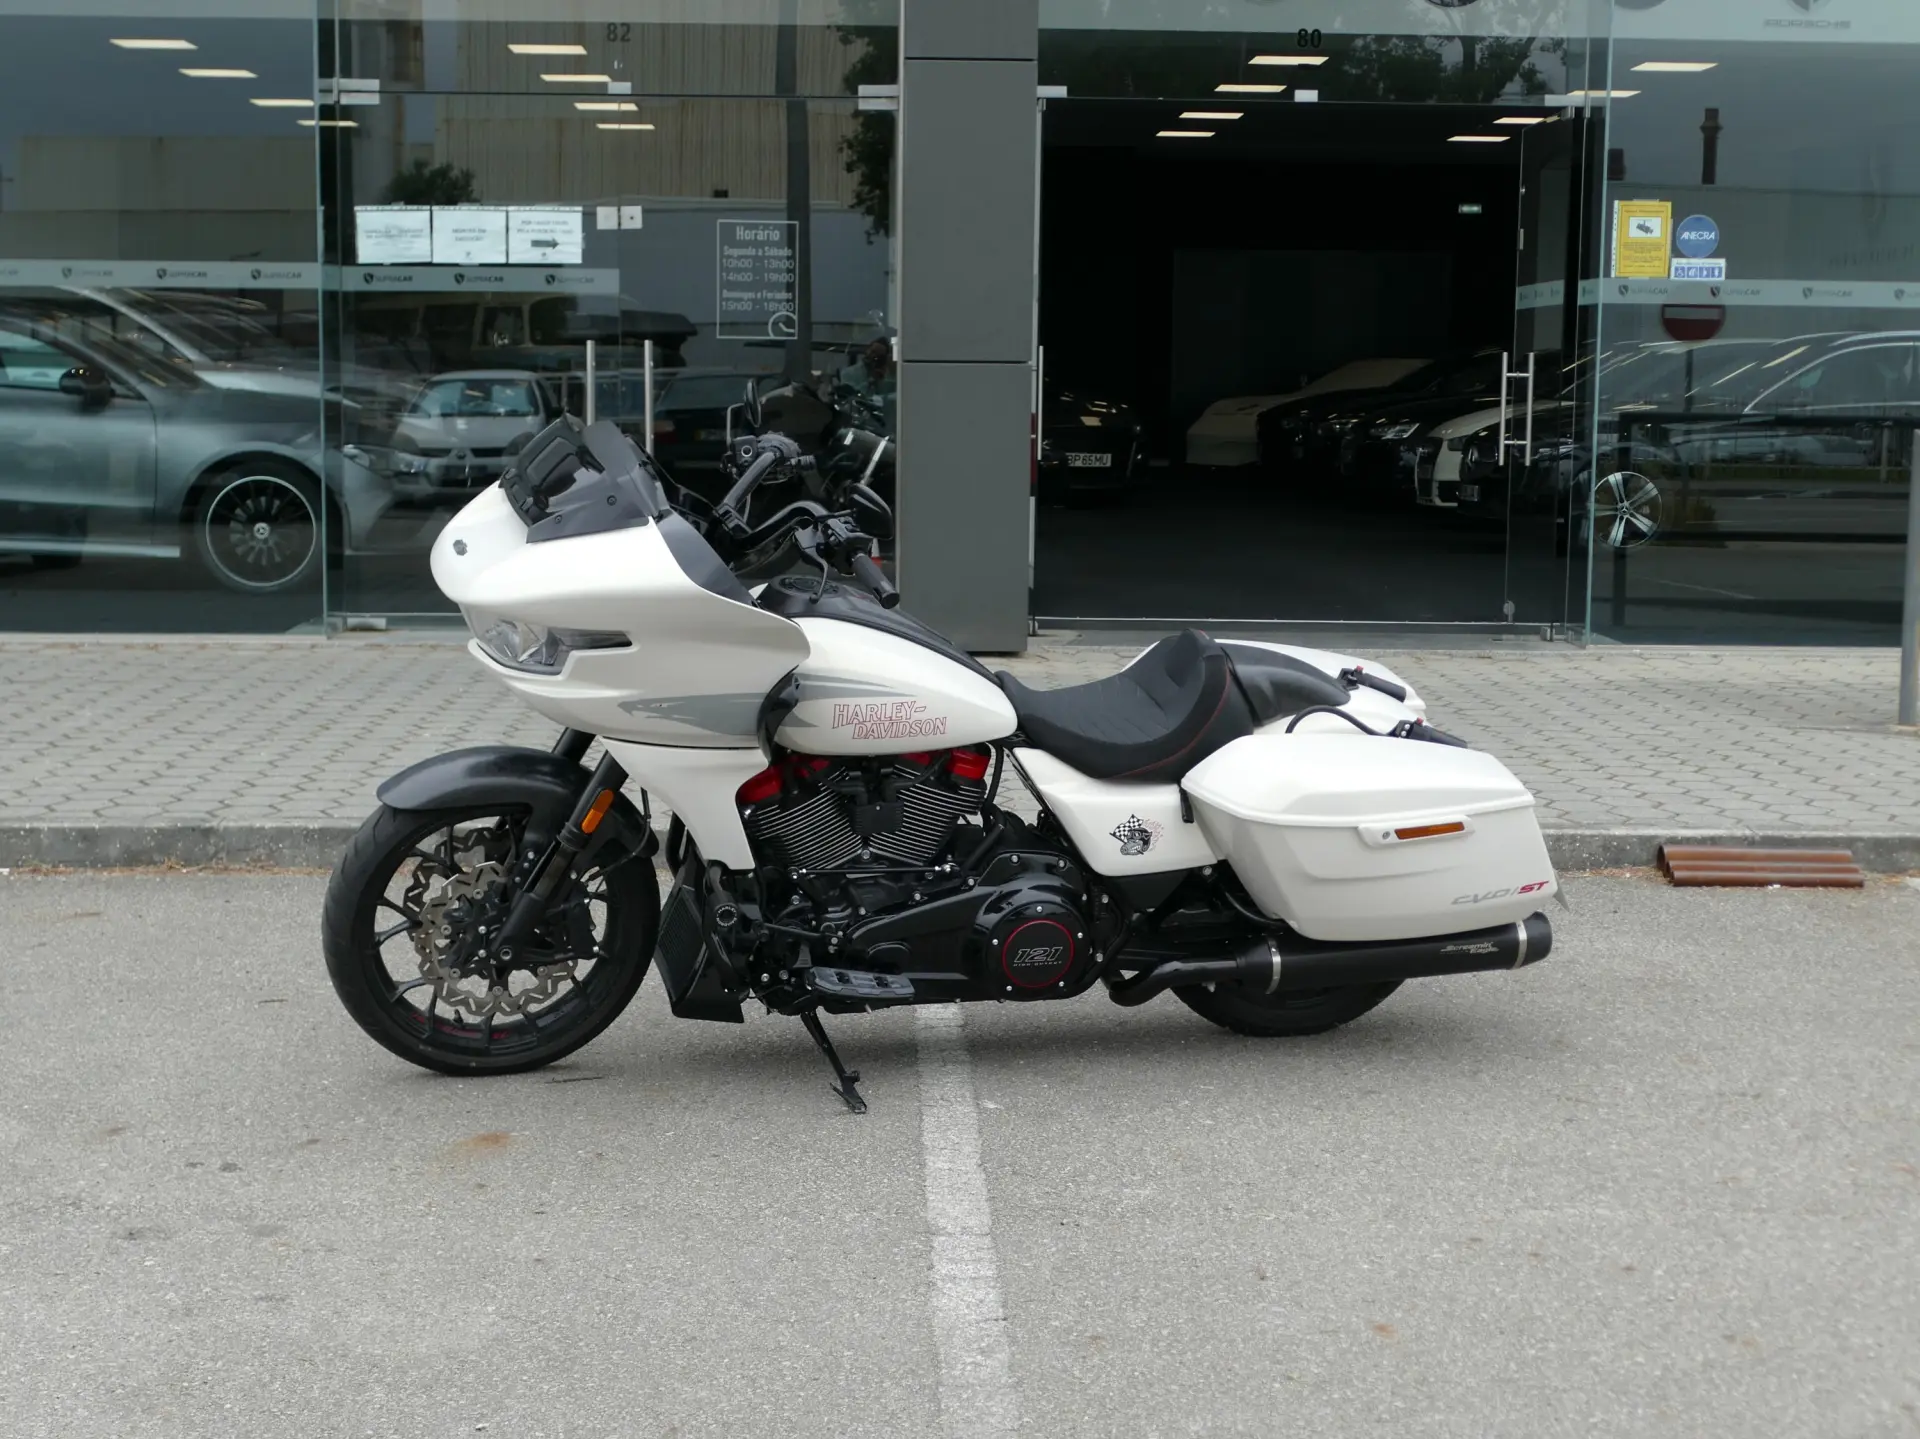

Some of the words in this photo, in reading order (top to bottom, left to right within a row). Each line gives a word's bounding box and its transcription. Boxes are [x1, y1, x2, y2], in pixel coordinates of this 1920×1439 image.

[607, 22, 631, 42] 82
[1297, 28, 1321, 48] 80
[736, 225, 780, 241] Horário
[1681, 231, 1716, 241] ANECRA
[722, 259, 752, 269] 10h00
[764, 260, 795, 270] 13h00
[722, 271, 752, 282] 14h00
[764, 272, 795, 283] 19h00
[722, 301, 752, 311] 15h00
[832, 701, 927, 729] HARLEY-
[852, 717, 947, 740] DAVIDSON
[1013, 946, 1063, 963] 121
